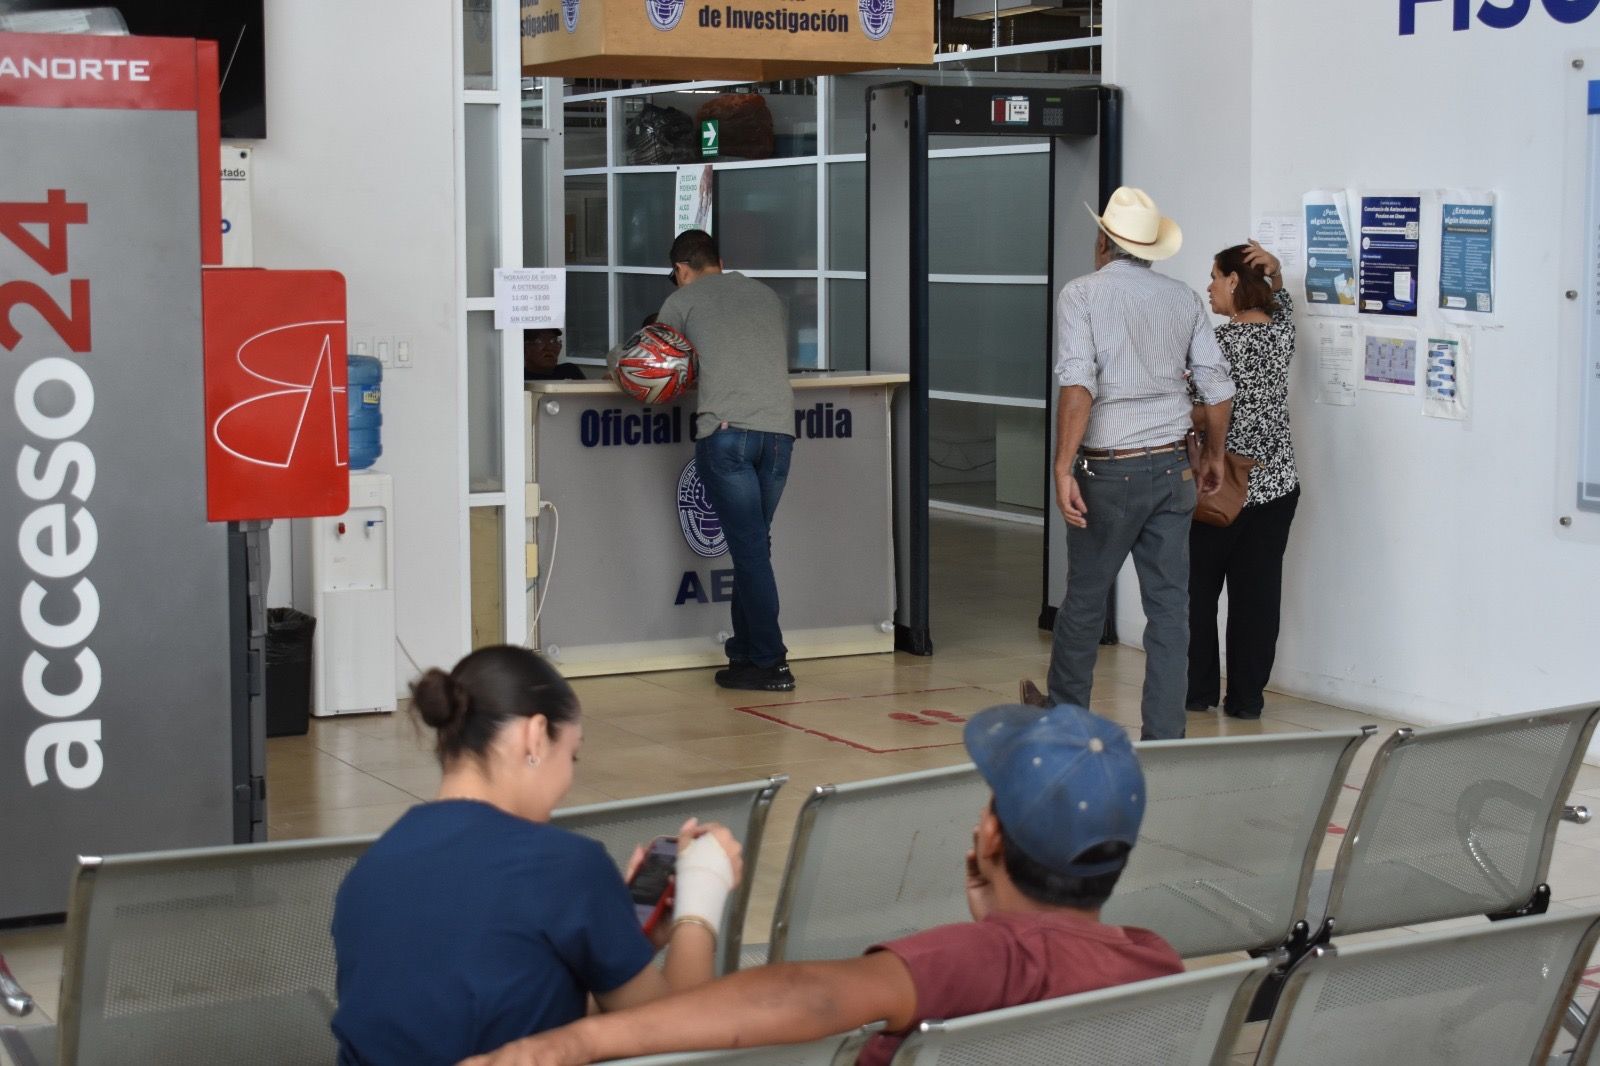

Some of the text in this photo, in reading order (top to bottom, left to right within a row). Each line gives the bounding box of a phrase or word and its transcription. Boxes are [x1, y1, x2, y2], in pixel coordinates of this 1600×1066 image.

[521, 9, 560, 38] stigación
[699, 5, 849, 34] de Investigación
[0, 57, 150, 81] ANORTE
[581, 407, 681, 447] Oficial
[795, 403, 852, 438] rdia
[674, 569, 735, 606] AE
